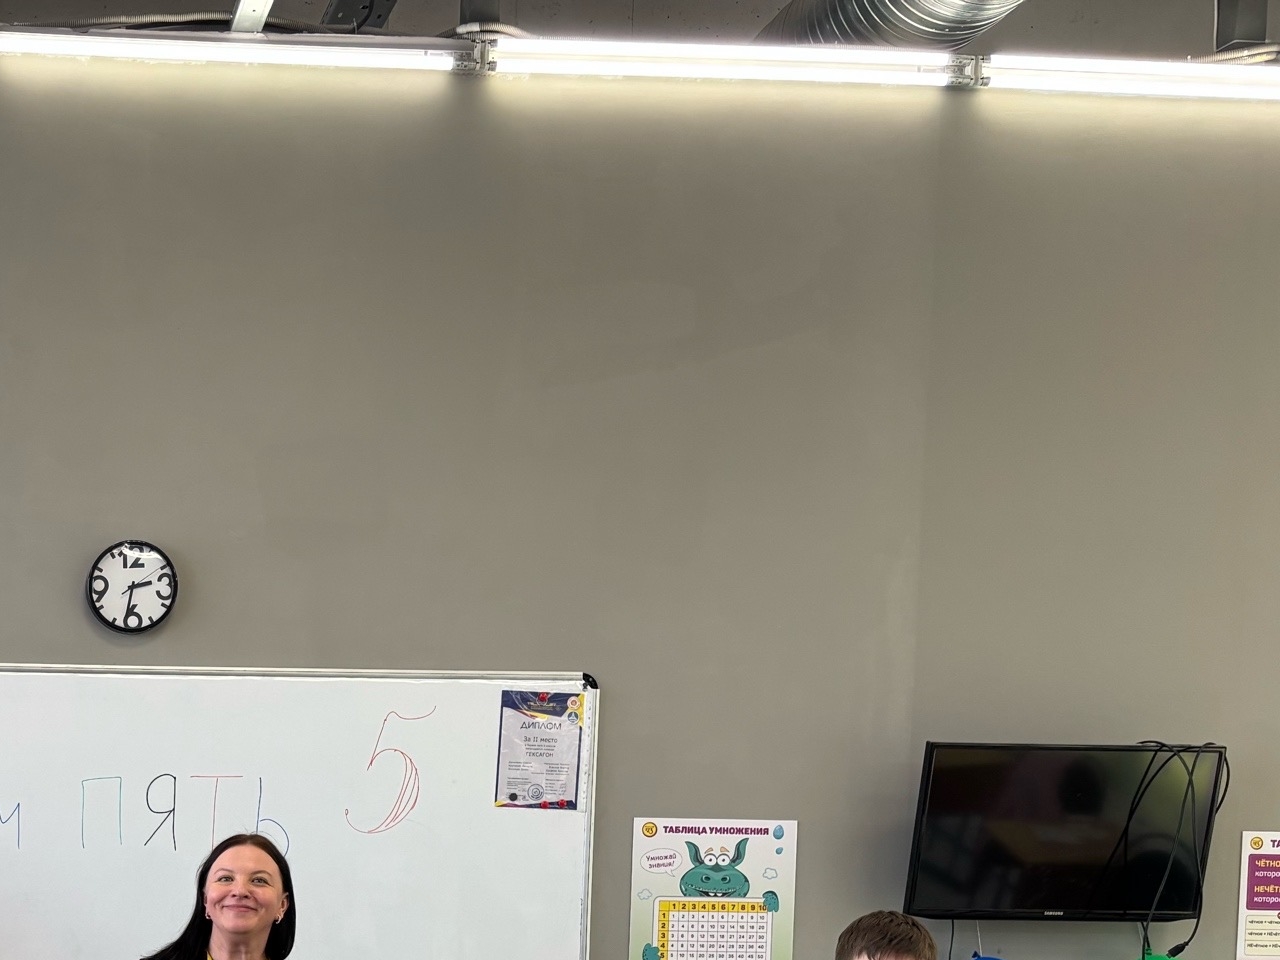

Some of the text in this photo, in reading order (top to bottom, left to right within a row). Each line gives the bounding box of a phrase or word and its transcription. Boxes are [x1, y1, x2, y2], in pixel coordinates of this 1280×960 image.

[93, 575, 109, 602] 9
[156, 572, 172, 600] 3
[123, 604, 143, 628] 6
[520, 721, 561, 730] ДИПЛОМ
[344, 704, 437, 835] 5
[81, 774, 290, 856] ПЯТЬ
[663, 826, 769, 835] ТАБЛИЦА УМНОЖЕНИЯ
[646, 853, 676, 861] Умножай
